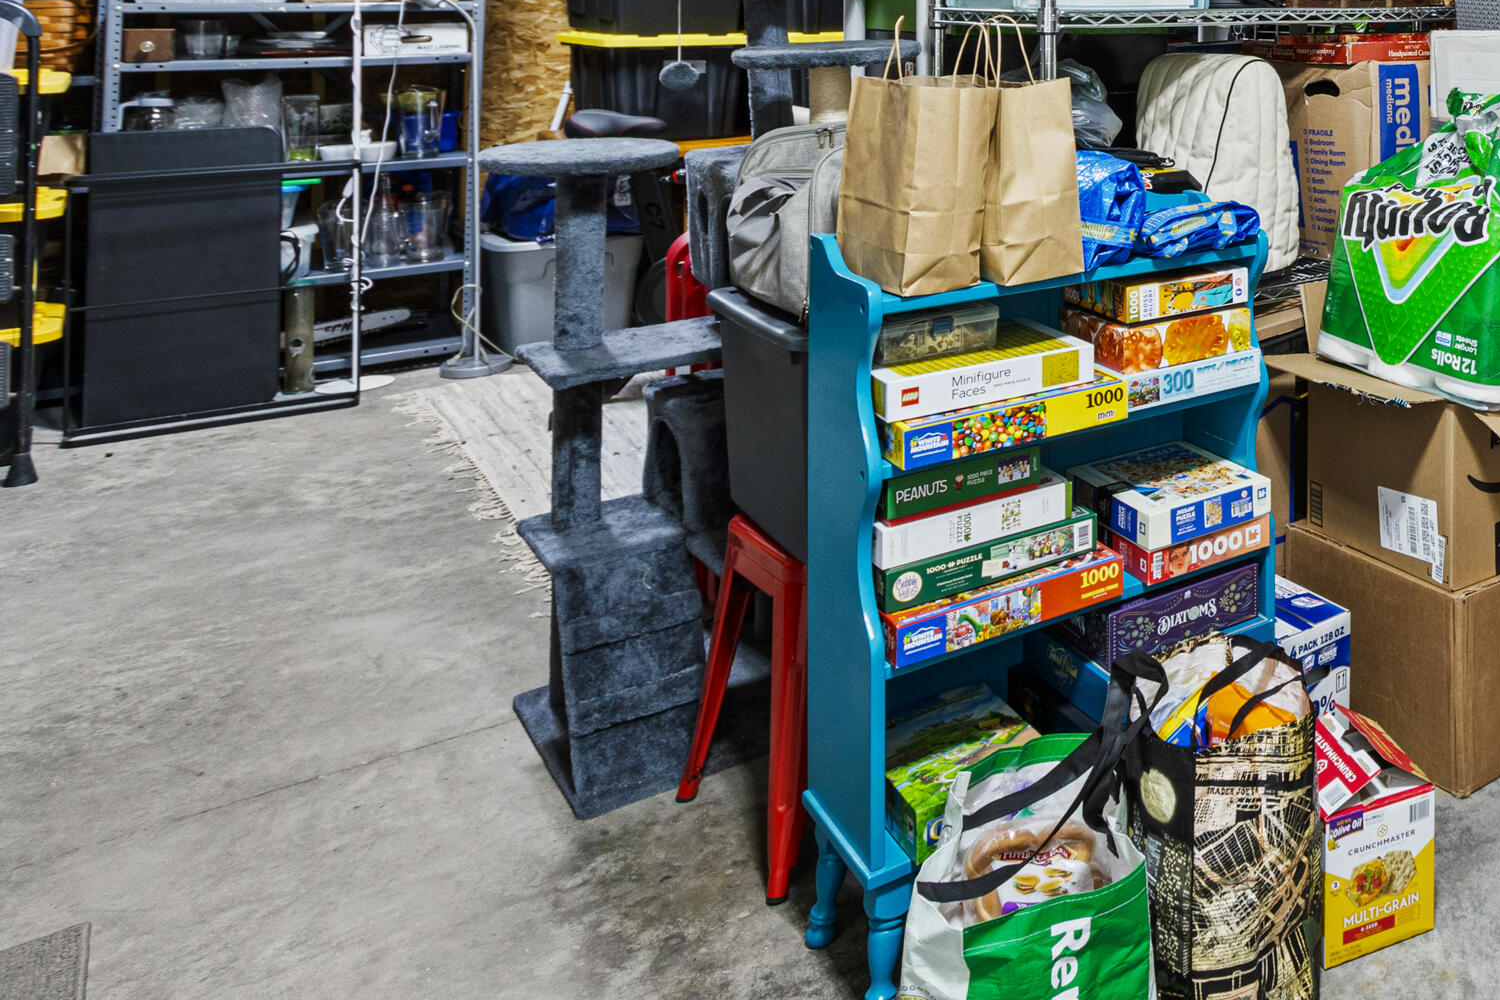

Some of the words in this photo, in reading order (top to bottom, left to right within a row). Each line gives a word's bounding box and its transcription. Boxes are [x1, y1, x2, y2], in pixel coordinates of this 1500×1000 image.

[1388, 49, 1418, 59] Handpainted
[1418, 50, 1431, 58] Cera
[1386, 78, 1394, 124] mediana
[1308, 129, 1334, 137] FRAGILE
[1309, 139, 1336, 147] Bedroom
[1309, 149, 1329, 158] Family
[1310, 158, 1329, 167] Dining
[1311, 168, 1333, 176] Kitchen
[1312, 187, 1340, 196] Basement
[1343, 188, 1491, 250] Bounty
[1129, 290, 1139, 320] 1000
[1454, 343, 1478, 356] Longer
[1455, 335, 1478, 347] Sheets
[1431, 348, 1461, 372] Rolls
[1461, 357, 1477, 375] 12
[951, 367, 1012, 388] Minifigure
[1163, 368, 1194, 395] 300
[902, 391, 919, 402] LEGO
[951, 384, 986, 400] Faces
[1085, 387, 1124, 410] 1000
[966, 477, 985, 487] PUZZLE
[967, 472, 980, 480] 1000
[895, 480, 948, 504] PEANUTS
[963, 512, 972, 535] 1000
[1176, 511, 1196, 522] PUZZLE
[1189, 530, 1244, 565] 1000
[925, 563, 947, 575] 1000
[956, 553, 983, 566] PUZZLE
[1080, 562, 1120, 589] 1000
[1157, 598, 1218, 636] DIATOMS
[903, 633, 943, 651] MOUNTAIN
[911, 629, 936, 641] WHITE
[1290, 645, 1298, 661] 4
[1298, 638, 1319, 655] PACK
[1320, 631, 1334, 644] 128
[1334, 626, 1345, 639] OZ
[1207, 787, 1235, 796] TRADER
[1333, 824, 1351, 838] Olive
[1351, 817, 1363, 830] Oil
[1347, 828, 1416, 857] CRUNCHMASTER
[1343, 891, 1420, 929] MULTI-GRAIN
